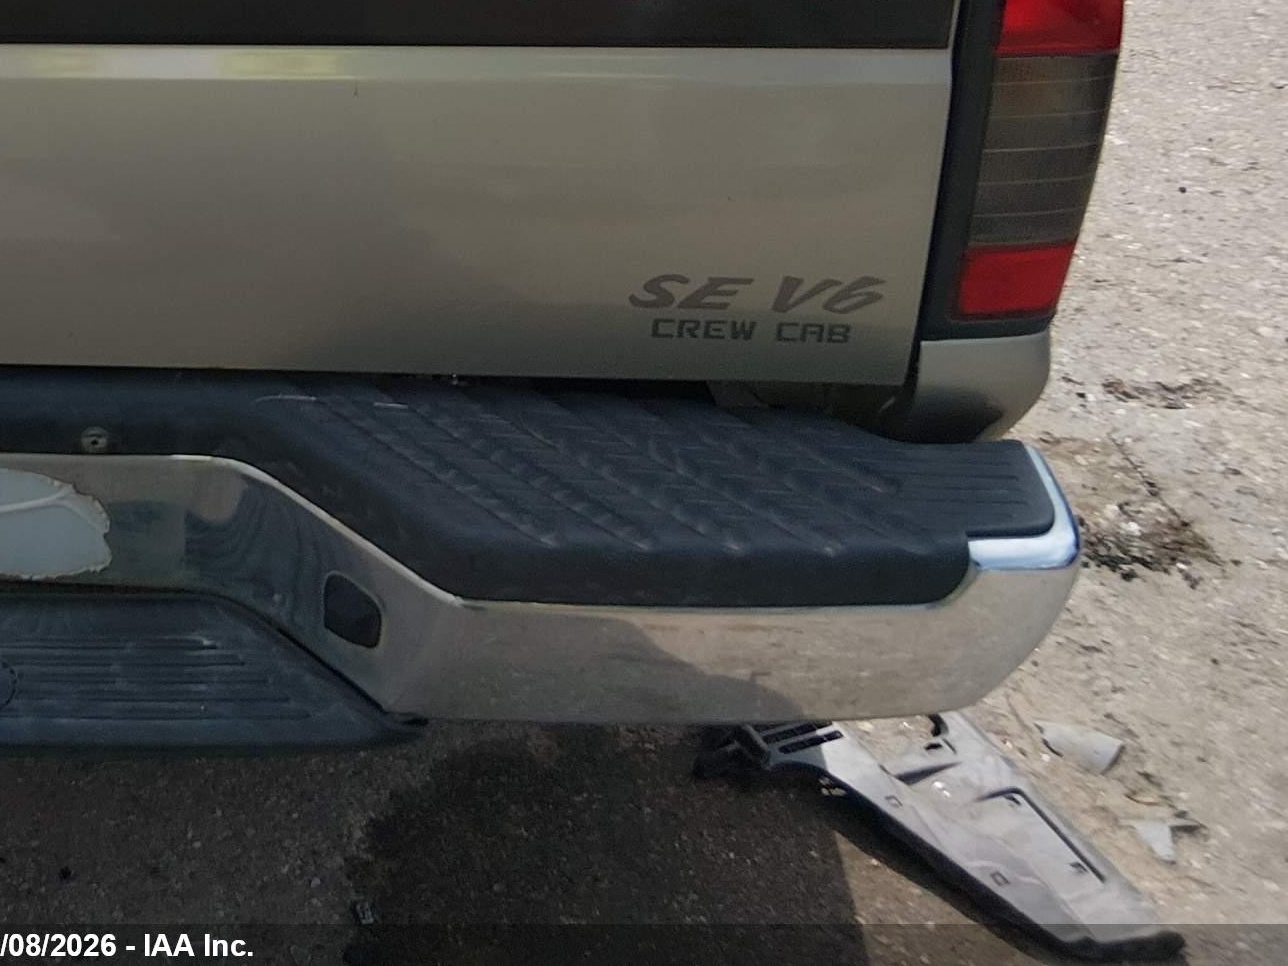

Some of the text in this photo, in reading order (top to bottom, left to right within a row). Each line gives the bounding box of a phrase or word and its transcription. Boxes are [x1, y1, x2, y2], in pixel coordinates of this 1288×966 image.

[628, 273, 886, 314] SE V6
[651, 318, 852, 344] CREW CAB
